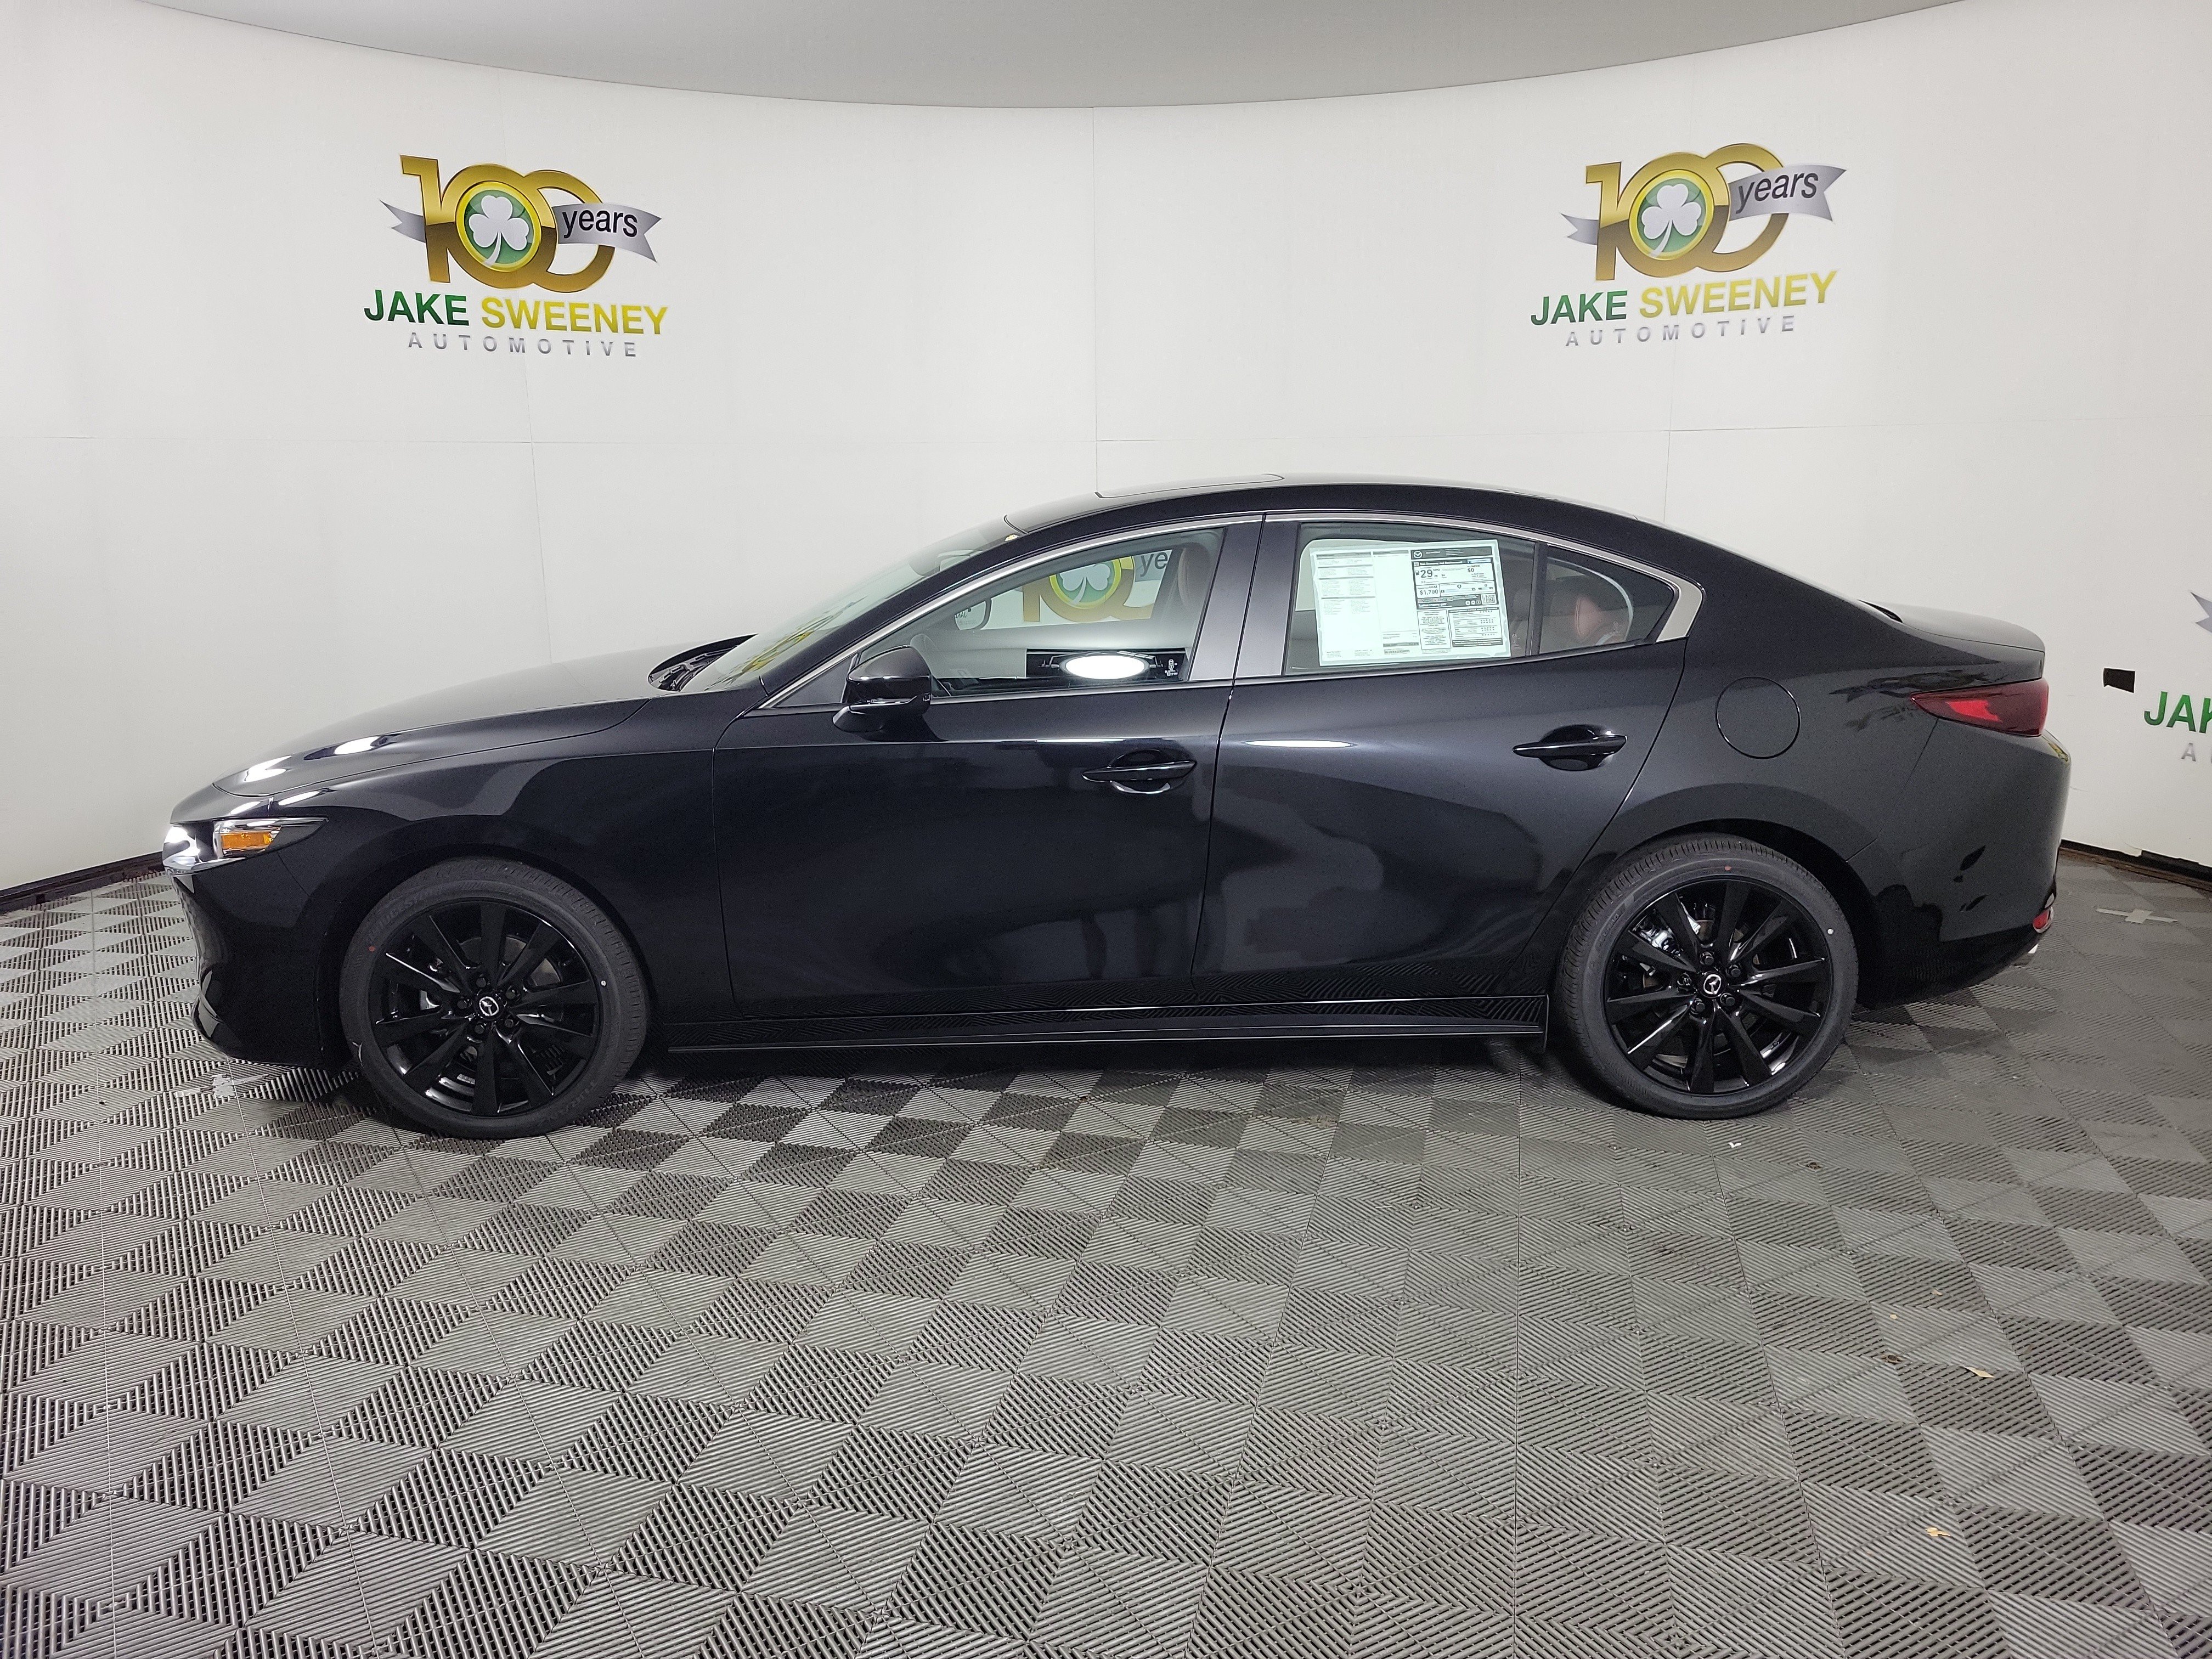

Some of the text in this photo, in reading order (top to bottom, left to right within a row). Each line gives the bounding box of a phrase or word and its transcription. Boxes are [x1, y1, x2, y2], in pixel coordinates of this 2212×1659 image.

[399, 154, 638, 294] 100 years
[1585, 143, 1819, 281] 100 years
[363, 289, 668, 335] JAKE SWEENEY
[1530, 270, 1837, 326] JAKE SWEENEY
[408, 331, 637, 358] AUTOMOTIVE
[1565, 315, 1796, 347] AUTOMOTIVE
[1420, 569, 1433, 578] 29
